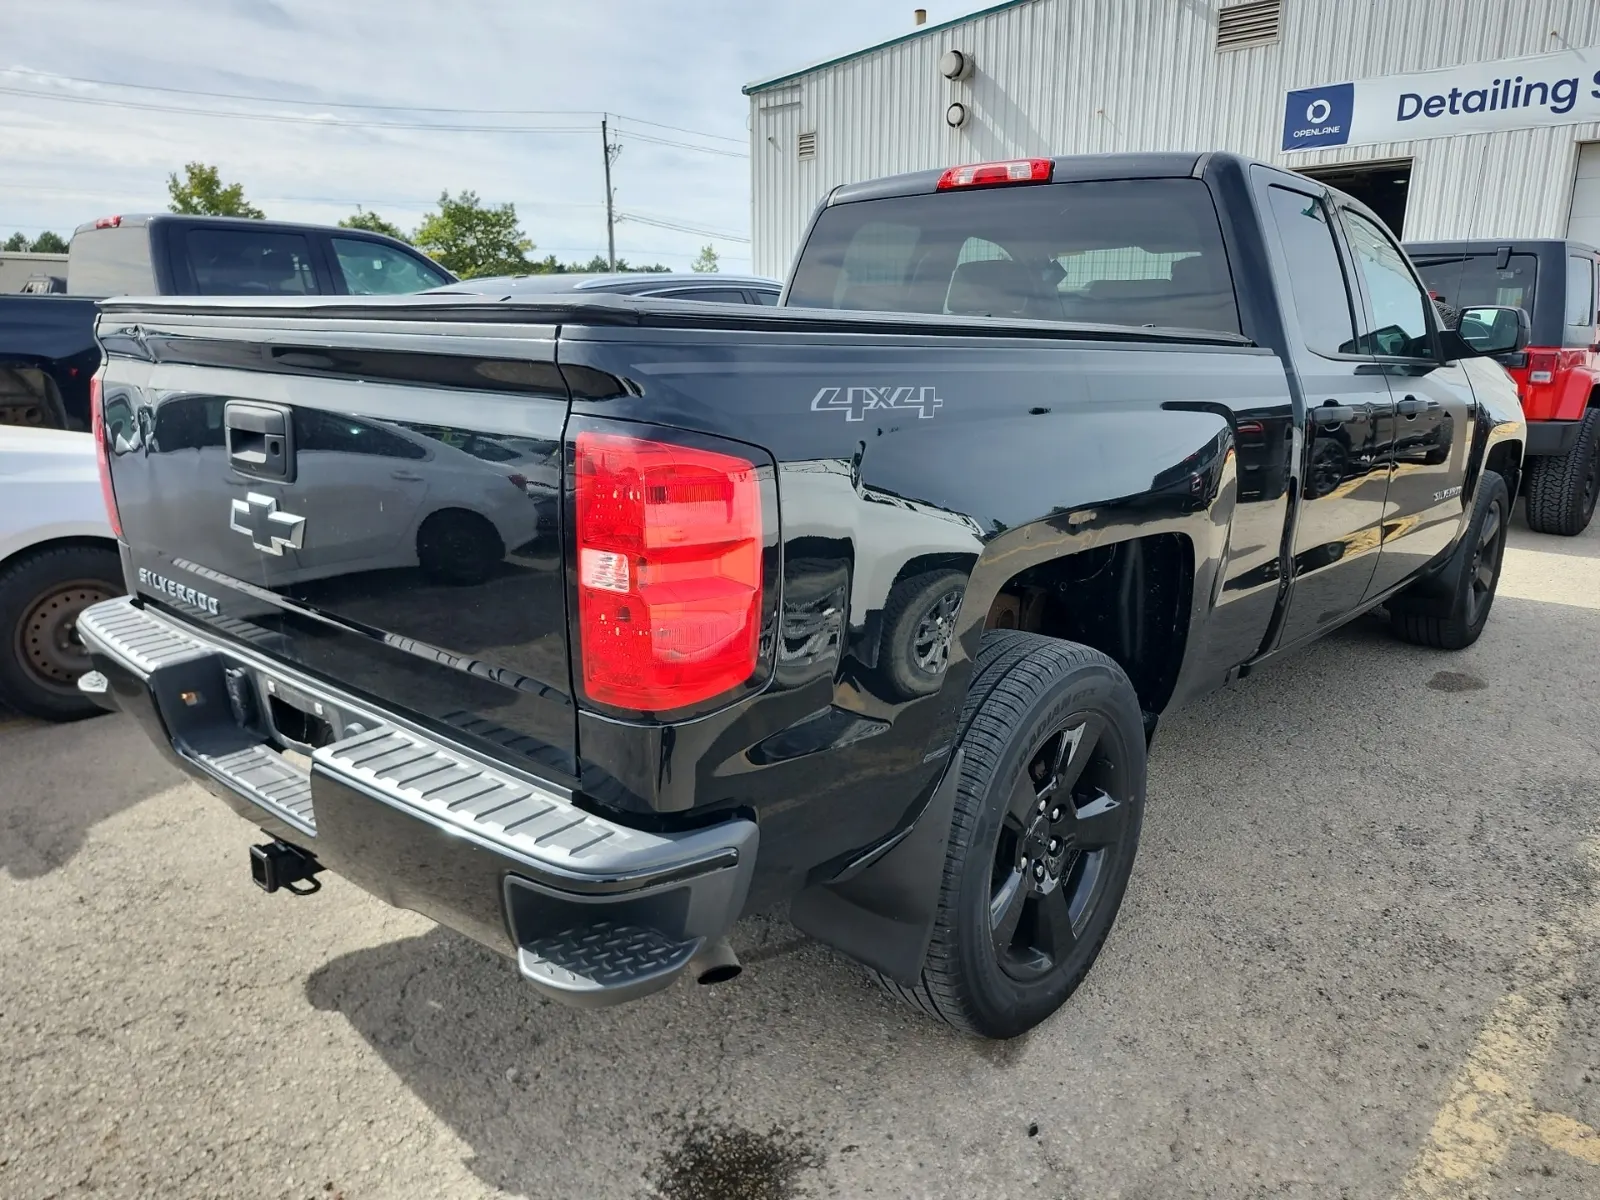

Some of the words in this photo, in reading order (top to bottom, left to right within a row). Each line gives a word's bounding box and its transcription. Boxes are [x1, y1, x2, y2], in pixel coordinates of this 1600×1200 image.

[1397, 76, 1579, 122] Detailing
[1293, 126, 1340, 138] OPENLANE
[138, 567, 219, 615] SILVERADO
